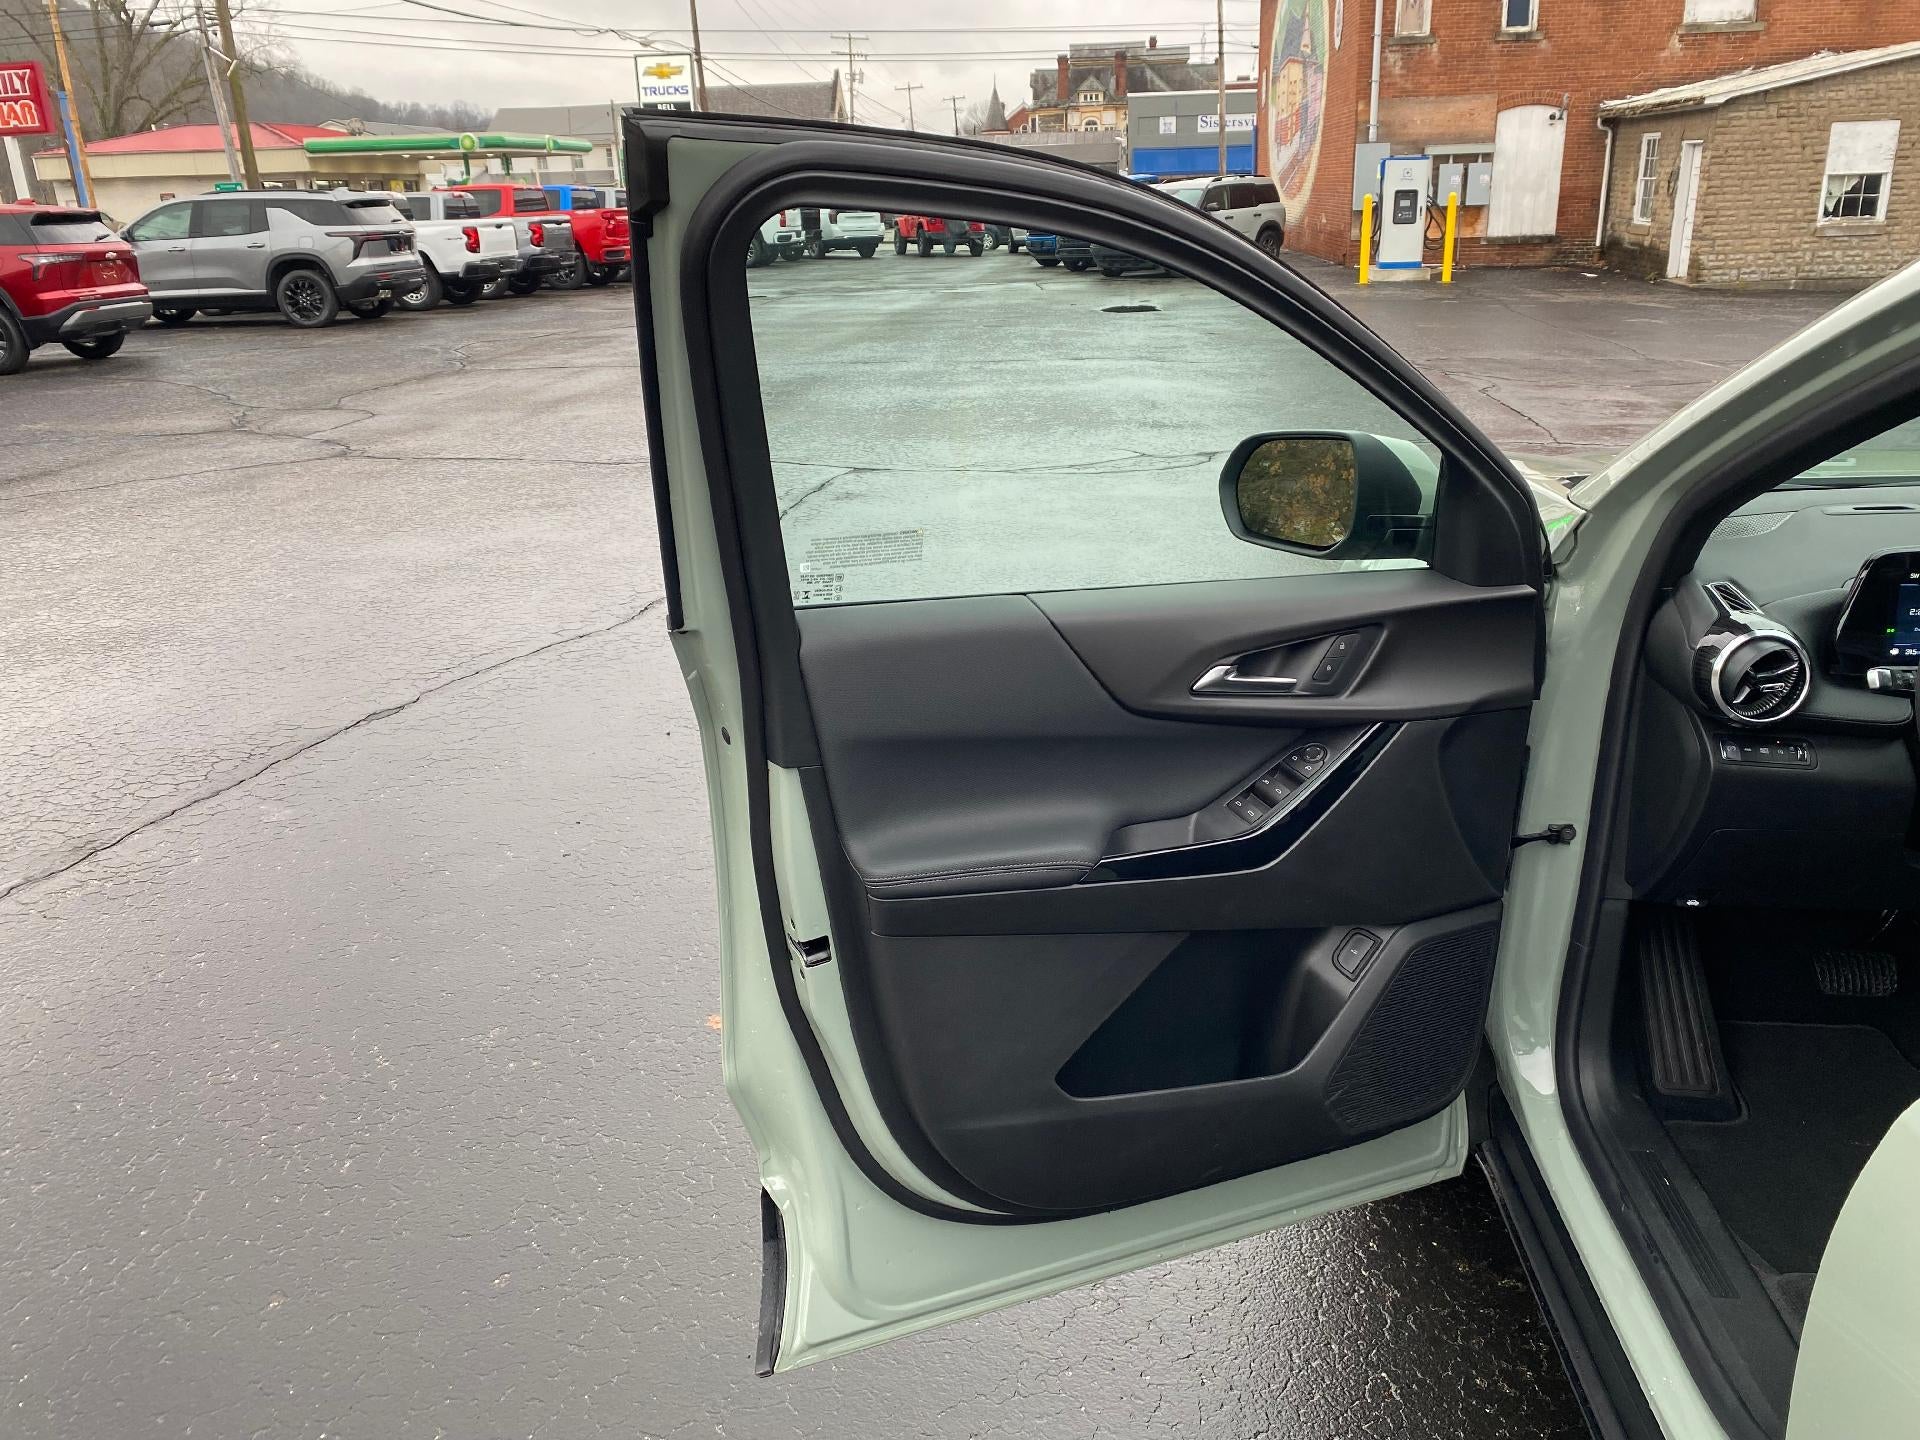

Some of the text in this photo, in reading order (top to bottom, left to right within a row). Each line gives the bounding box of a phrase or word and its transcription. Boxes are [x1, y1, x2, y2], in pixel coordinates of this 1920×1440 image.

[0, 69, 30, 97] ILY
[641, 85, 689, 97] TRUCKS
[656, 103, 677, 111] BELL
[1200, 114, 1256, 129] Sisersvi
